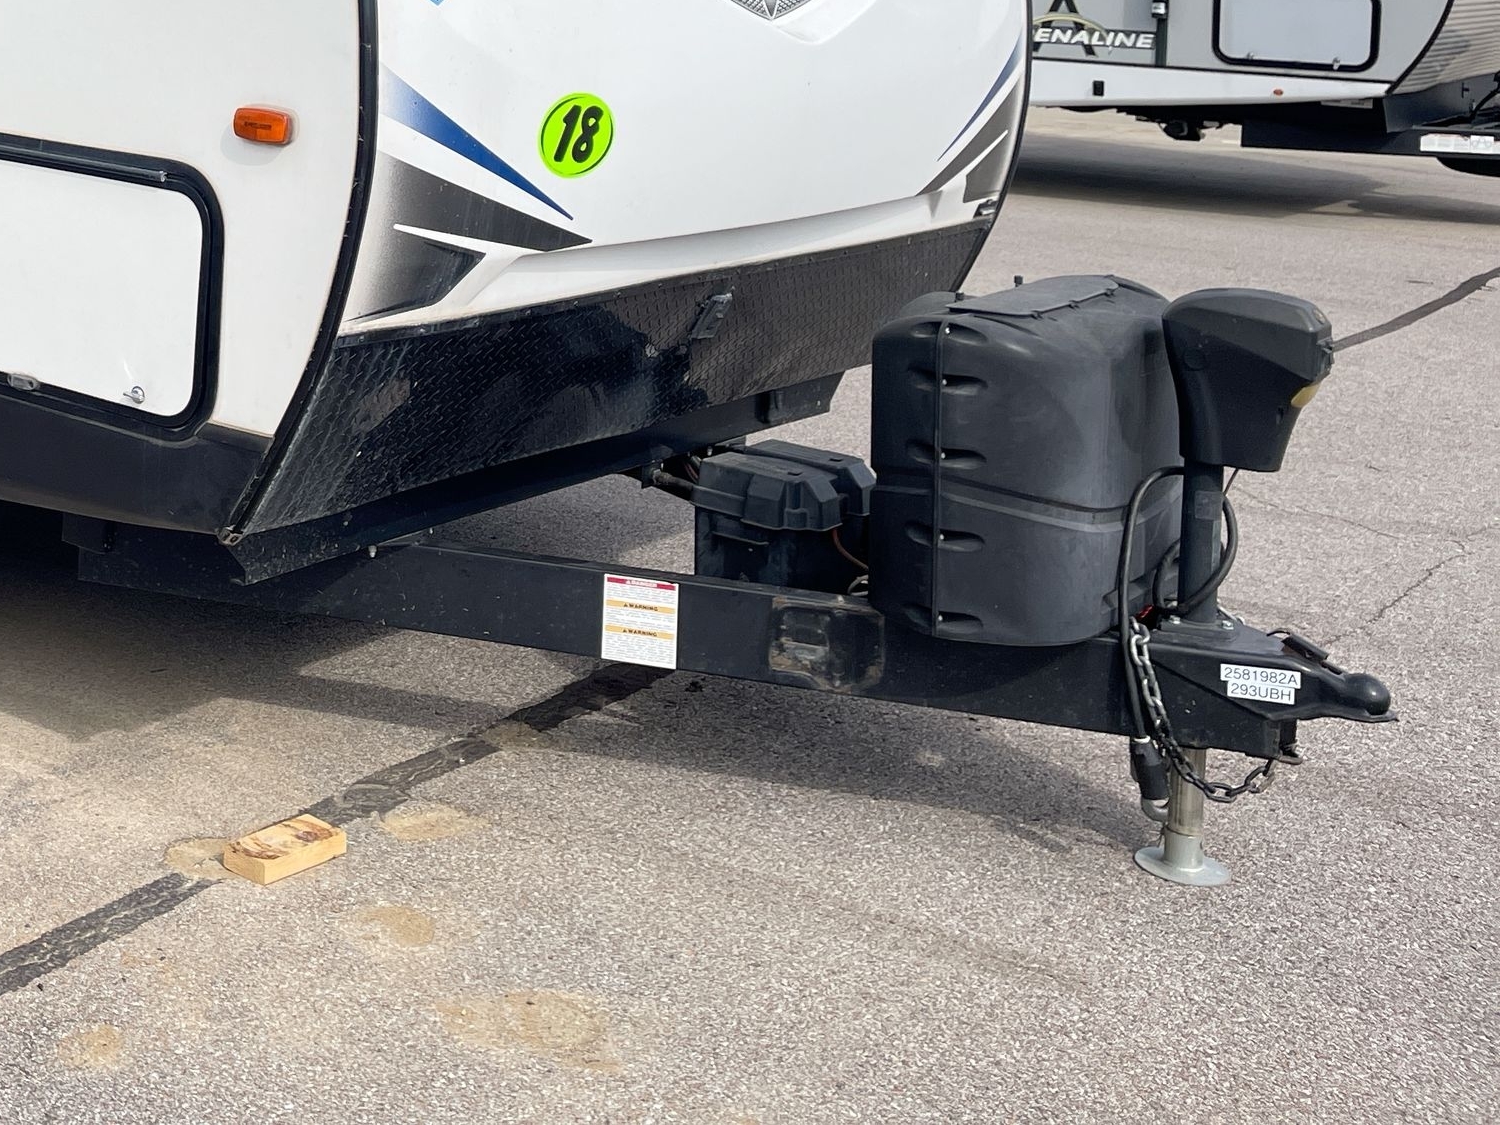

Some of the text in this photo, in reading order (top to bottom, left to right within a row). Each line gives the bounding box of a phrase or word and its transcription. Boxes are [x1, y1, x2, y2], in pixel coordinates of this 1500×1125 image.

[1032, 27, 1155, 49] ENALINE
[553, 104, 604, 163] 18
[629, 604, 658, 612] WARNING
[628, 629, 657, 637] WARNING
[1224, 666, 1298, 685] 2581982A
[1231, 683, 1291, 701] 293UBH
